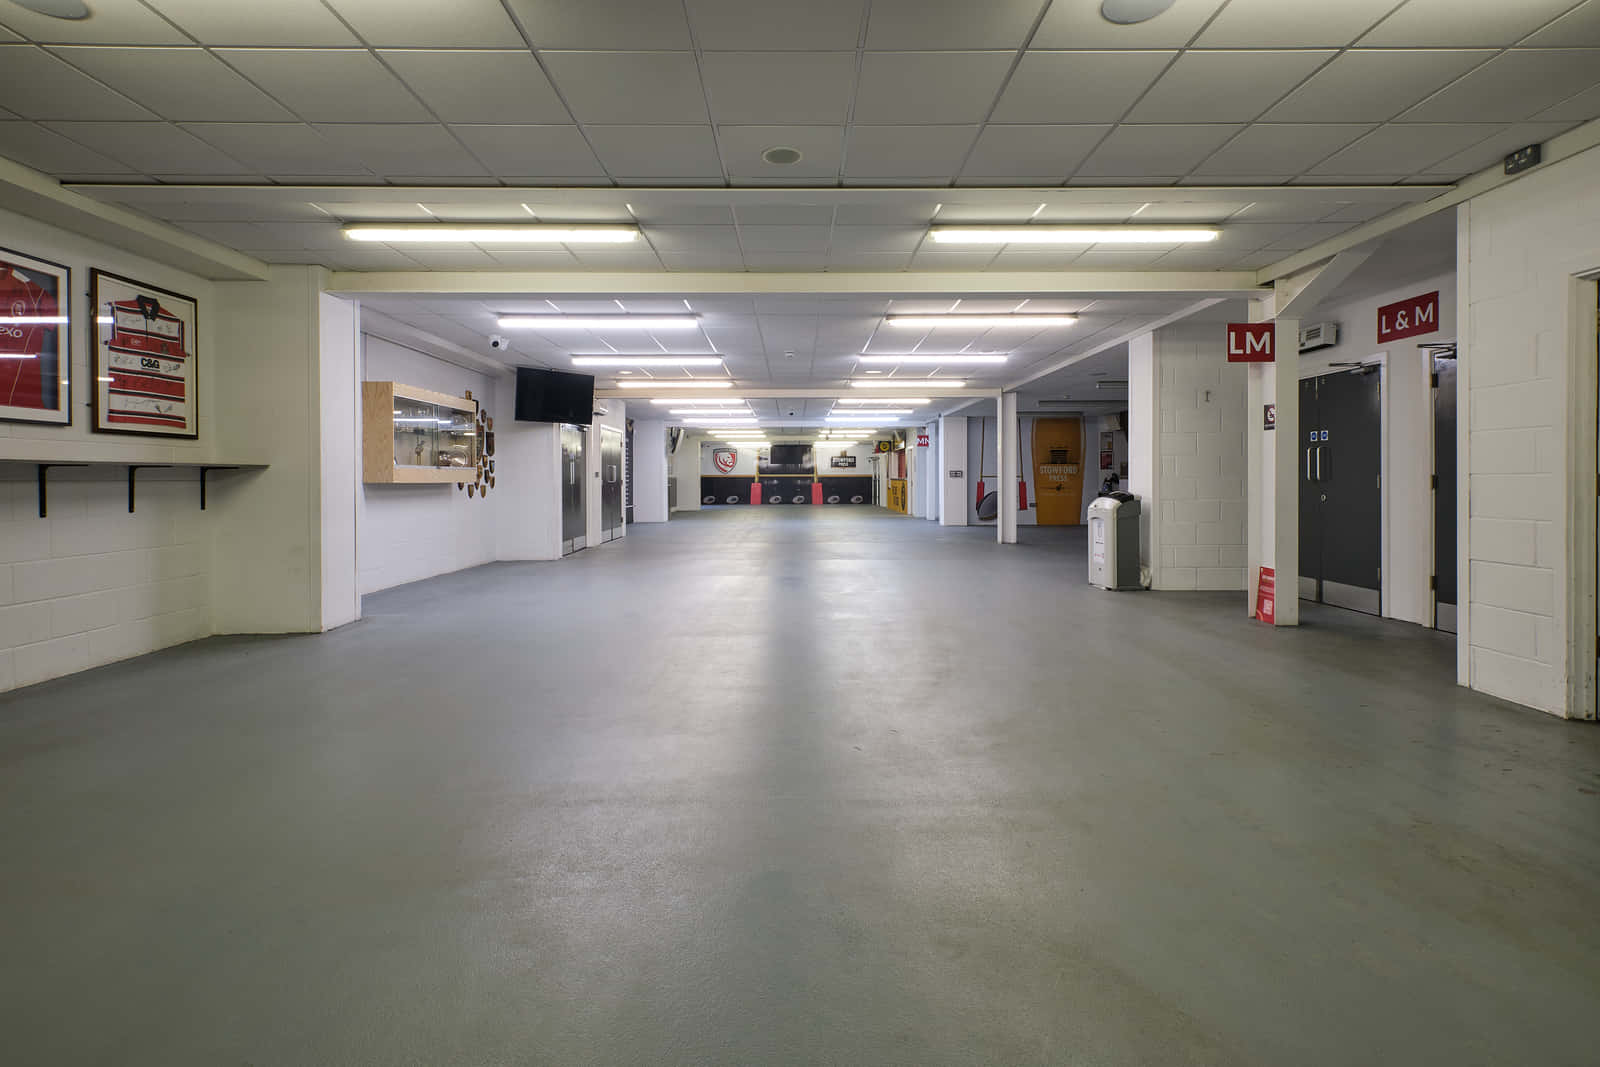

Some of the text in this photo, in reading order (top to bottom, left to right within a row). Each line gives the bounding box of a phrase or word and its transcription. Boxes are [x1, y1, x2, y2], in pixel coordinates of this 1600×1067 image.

[1382, 302, 1433, 334] L & M
[1229, 331, 1271, 354] LM
[141, 358, 160, 369] C&G
[1040, 465, 1077, 474] STOWFORD
